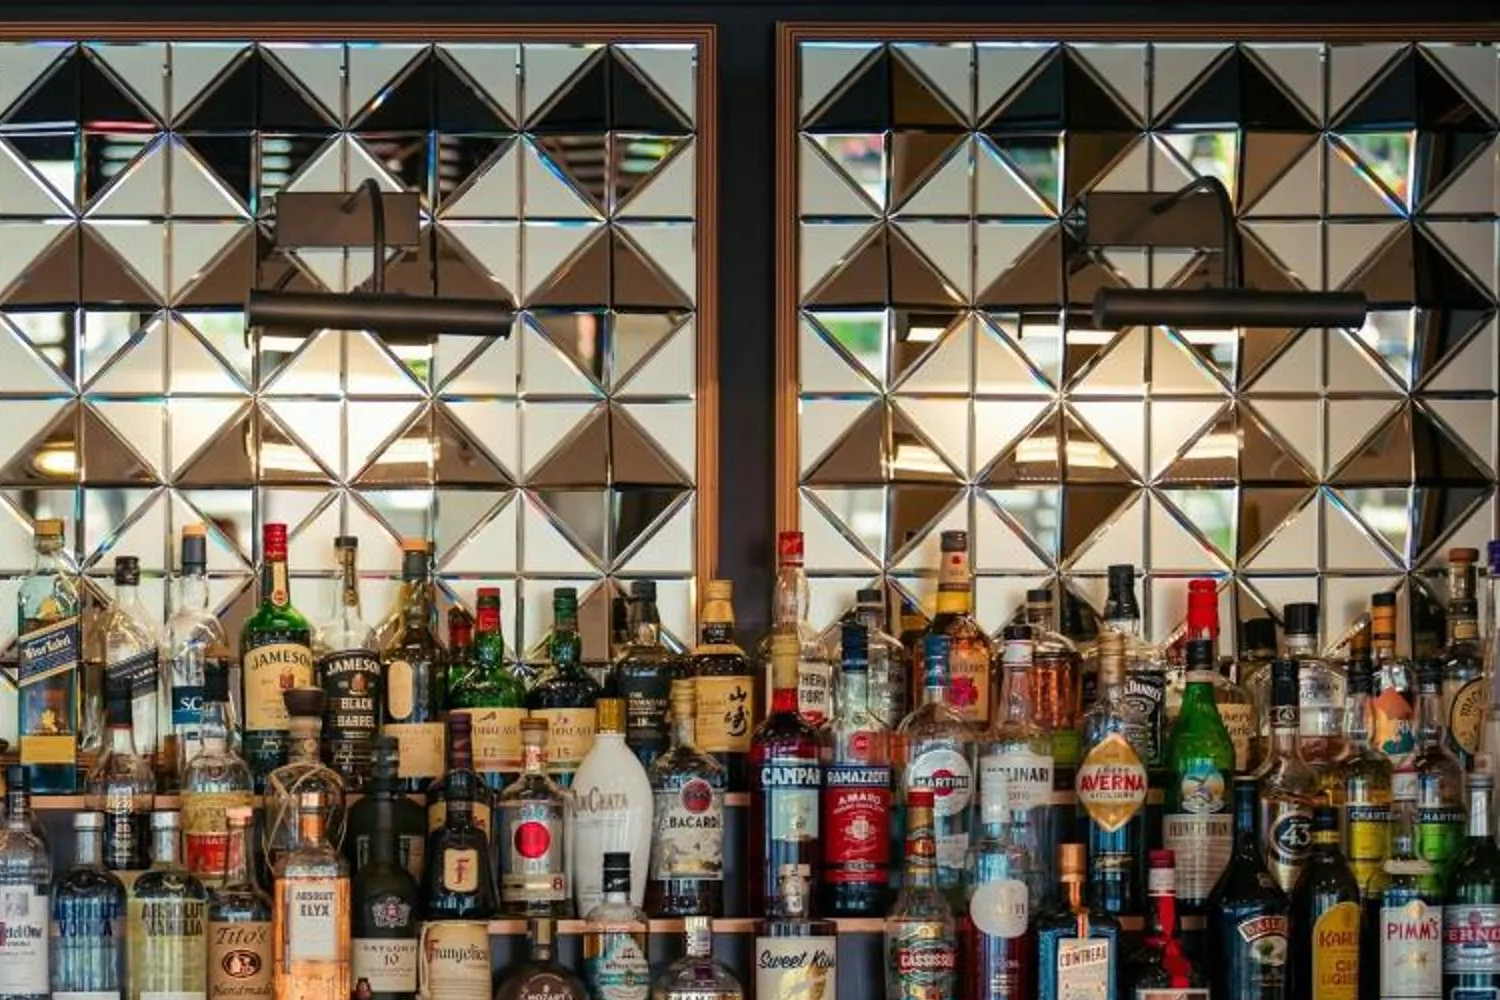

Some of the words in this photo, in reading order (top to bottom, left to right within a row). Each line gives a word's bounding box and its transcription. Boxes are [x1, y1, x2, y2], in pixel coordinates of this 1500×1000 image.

[252, 649, 310, 670] JAMESON
[326, 658, 381, 676] JAMESON
[761, 767, 821, 785] CAMPA
[1081, 774, 1144, 791] AVERNA
[668, 816, 722, 830] BACARDI
[299, 905, 330, 917] ELYX
[215, 924, 267, 945] Tito's
[1386, 917, 1440, 942] PIMM'S
[758, 949, 808, 969] Sweet
